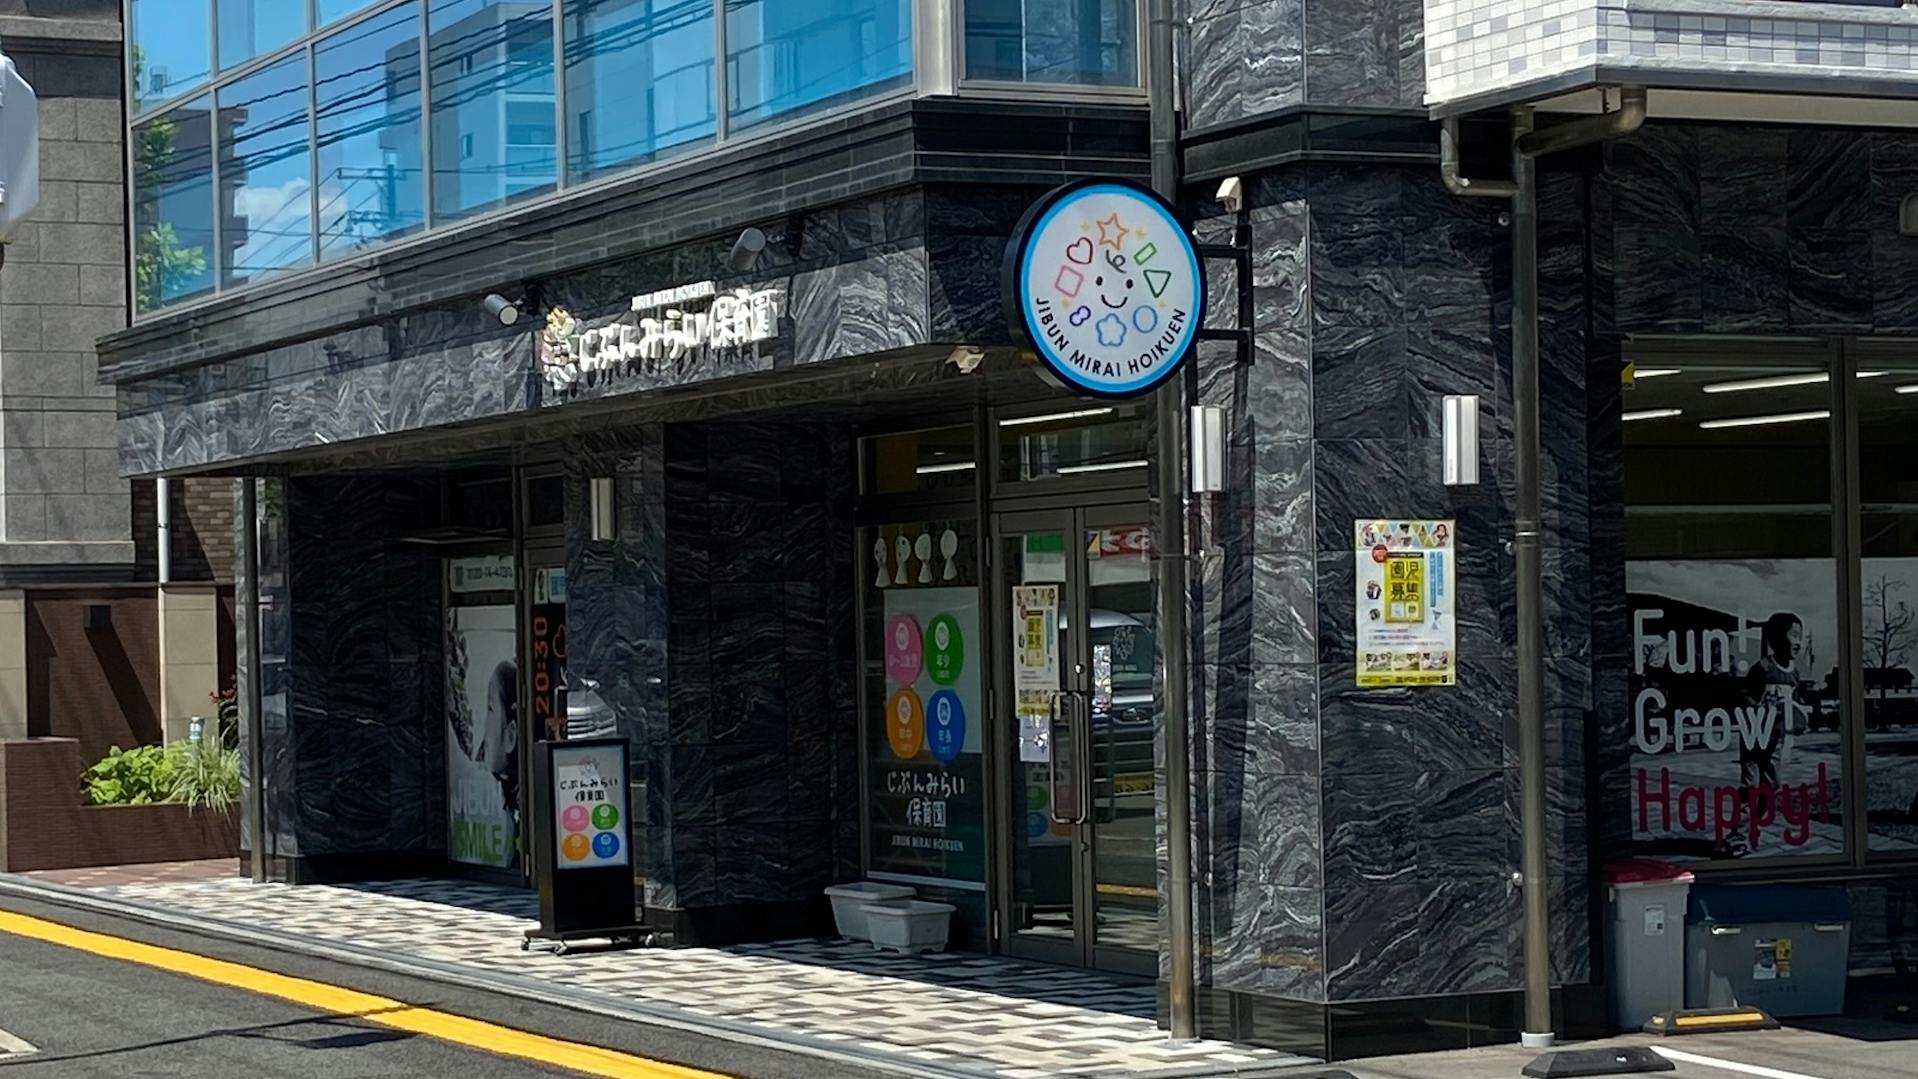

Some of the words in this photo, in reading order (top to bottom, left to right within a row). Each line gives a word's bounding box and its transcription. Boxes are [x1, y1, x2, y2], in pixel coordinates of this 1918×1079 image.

[1036, 297, 1070, 352] JIBUN
[1069, 349, 1121, 377] MIRAI
[1128, 308, 1187, 375] HOIKUEN
[533, 615, 550, 715] 20:30
[1633, 608, 1749, 675] Fun!
[886, 769, 966, 799] じぶんみらい
[905, 796, 947, 828] 保育園
[1636, 762, 1830, 849] Happy!
